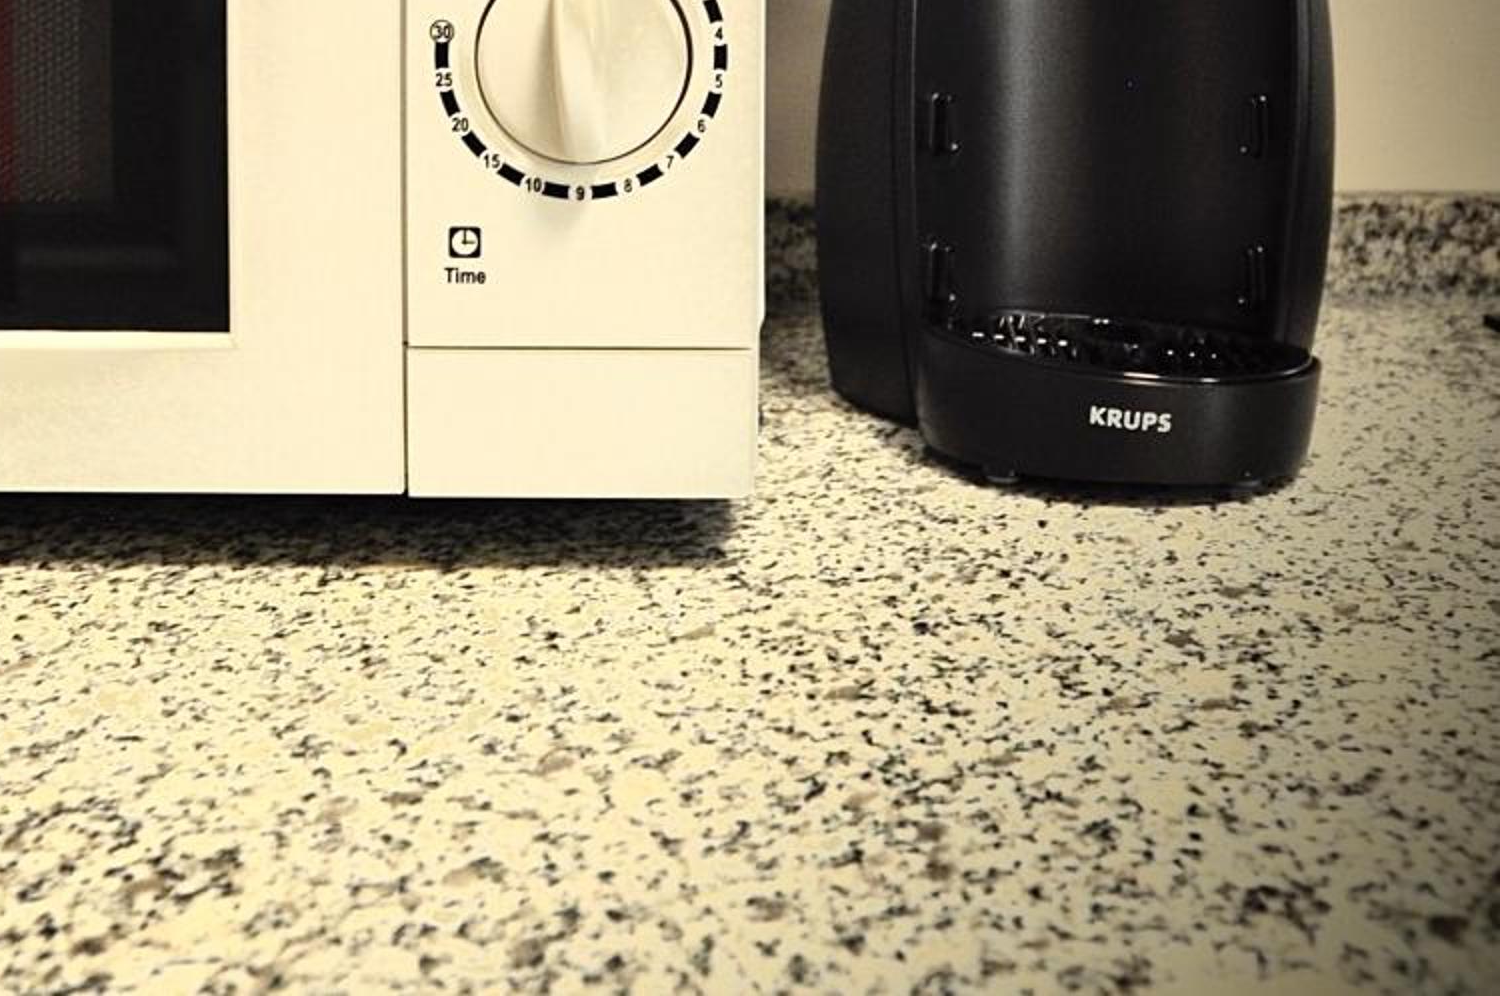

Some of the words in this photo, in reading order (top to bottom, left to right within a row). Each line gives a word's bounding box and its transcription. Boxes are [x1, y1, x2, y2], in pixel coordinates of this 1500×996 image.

[434, 26, 451, 39] 30
[715, 27, 723, 40] 4
[435, 73, 453, 86] 25
[715, 75, 723, 87] 5
[451, 118, 468, 132] 20
[697, 120, 706, 133] 6
[483, 154, 501, 168] 15
[666, 156, 675, 168] 7
[525, 177, 543, 192] 10
[624, 178, 633, 192] 8
[576, 187, 585, 200] 9
[444, 267, 486, 284] Time
[1089, 405, 1172, 433] KRUPS
